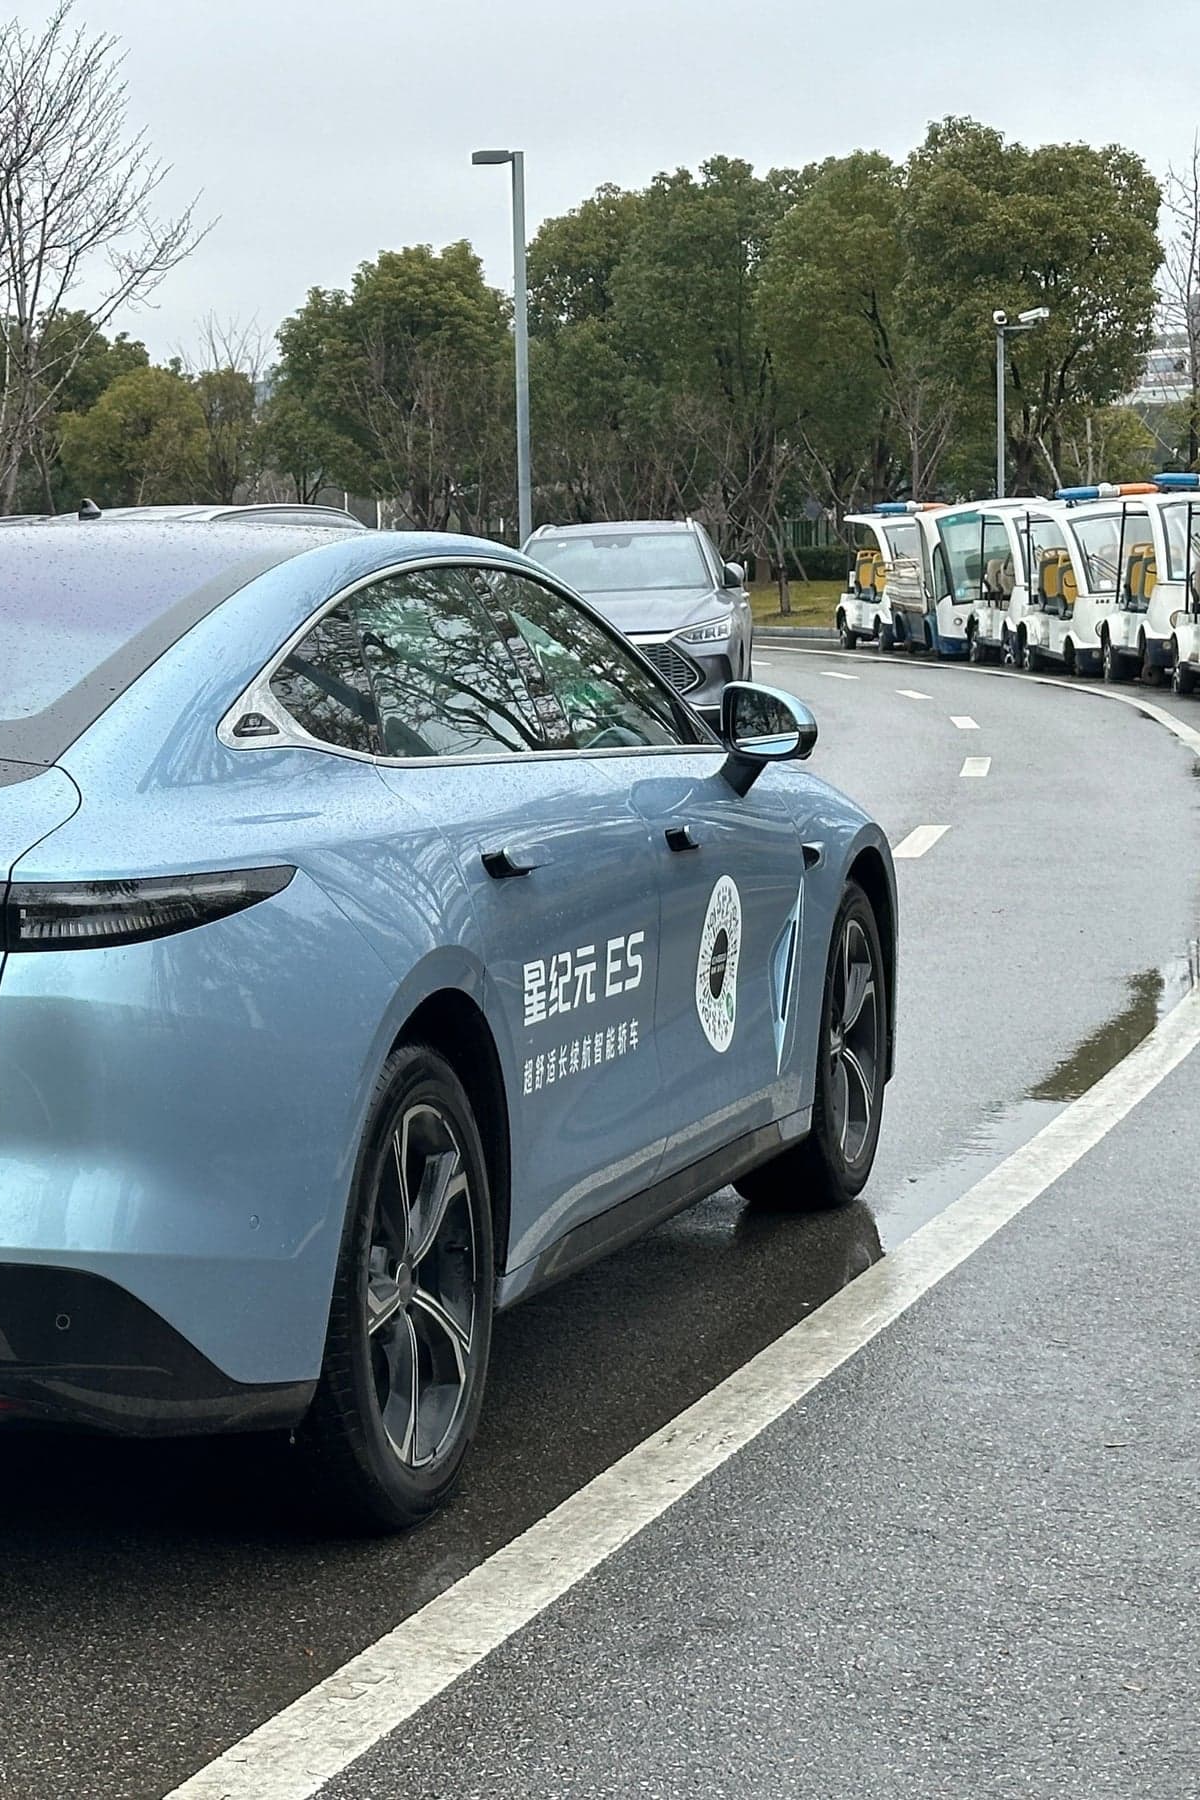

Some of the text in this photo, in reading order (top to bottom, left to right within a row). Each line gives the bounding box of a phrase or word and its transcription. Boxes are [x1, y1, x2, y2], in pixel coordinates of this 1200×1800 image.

[522, 930, 645, 1027] 星纪元 ES
[523, 1017, 639, 1096] 超舒适长续航智能轿车
